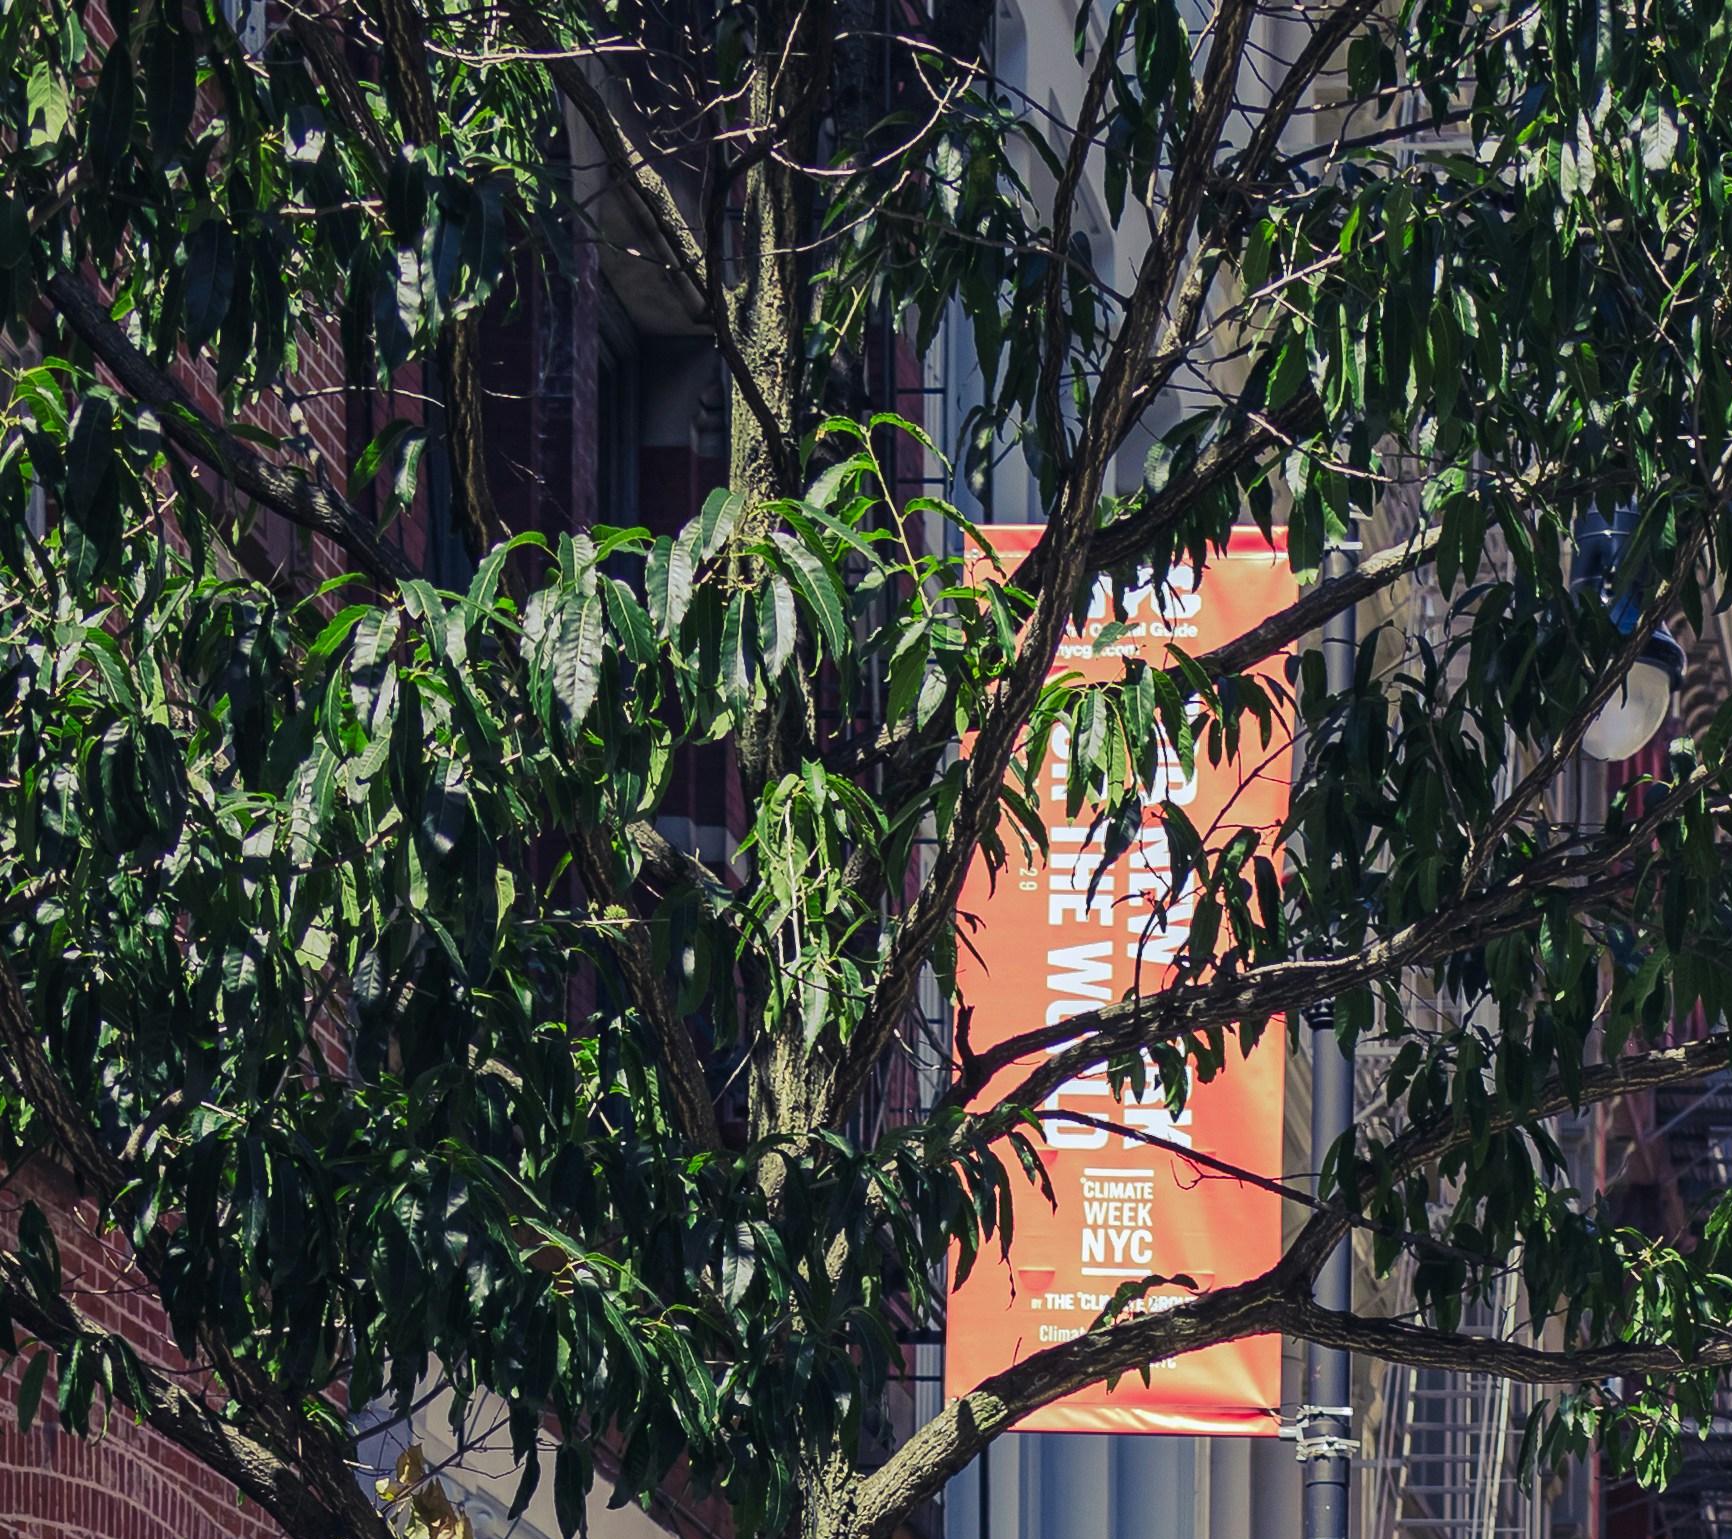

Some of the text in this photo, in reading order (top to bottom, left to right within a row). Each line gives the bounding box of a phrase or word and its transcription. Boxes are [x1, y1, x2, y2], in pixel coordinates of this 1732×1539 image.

[1057, 643, 1140, 659] nycg.com
[1083, 1201, 1153, 1227] WEEK
[1081, 1227, 1153, 1264] NYC
[1044, 1293, 1075, 1310] THE
